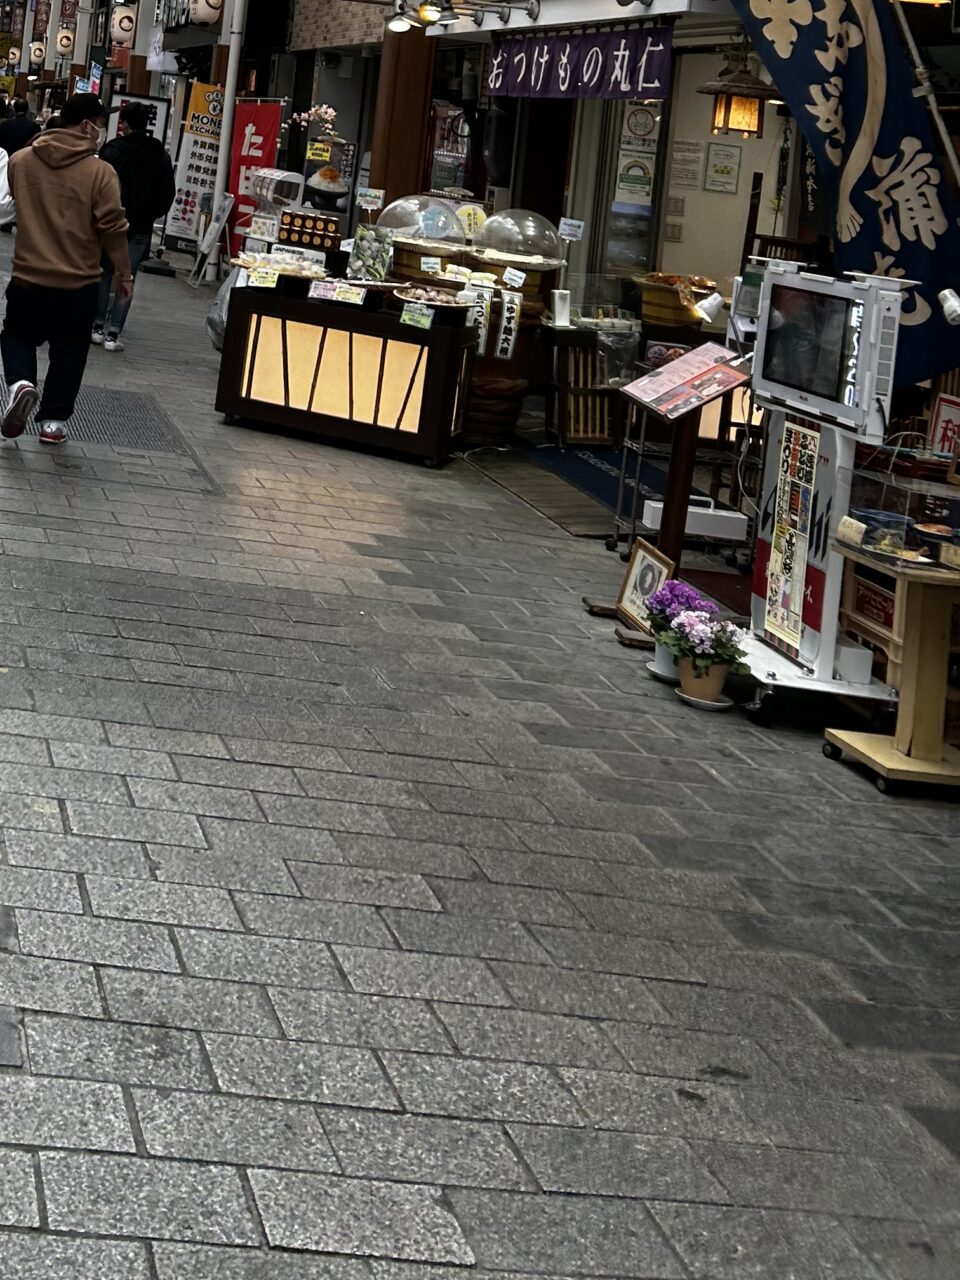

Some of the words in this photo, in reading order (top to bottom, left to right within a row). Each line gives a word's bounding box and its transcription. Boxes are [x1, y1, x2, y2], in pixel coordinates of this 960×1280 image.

[488, 36, 665, 91] おつけもの丸仁
[191, 112, 223, 130] MONE
[189, 124, 221, 138] EXCHAN
